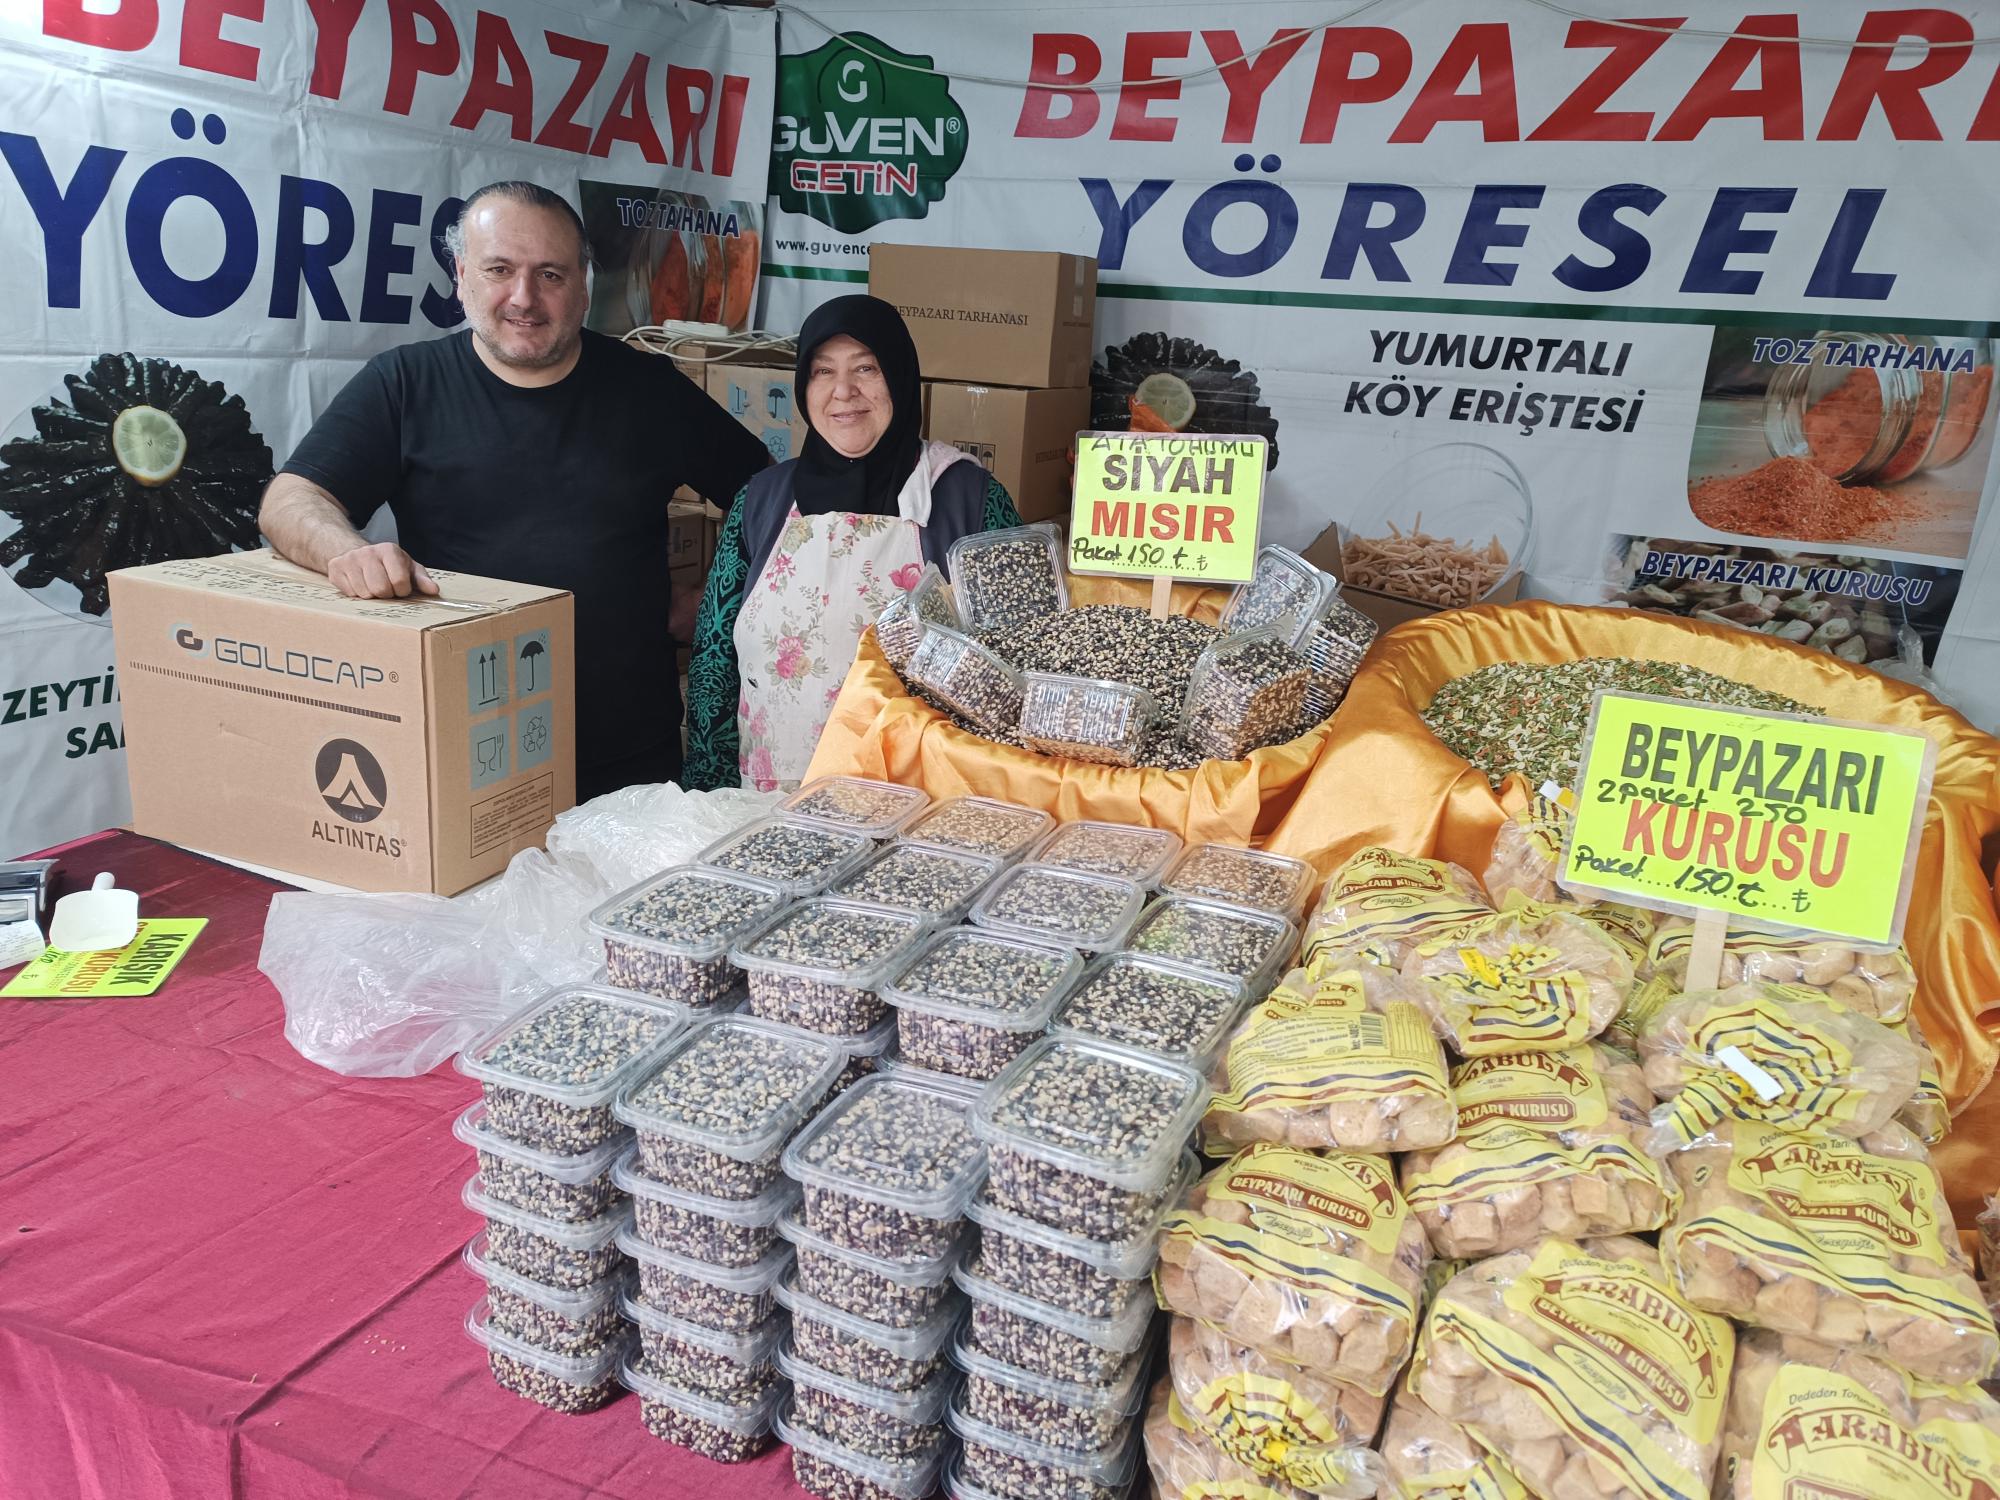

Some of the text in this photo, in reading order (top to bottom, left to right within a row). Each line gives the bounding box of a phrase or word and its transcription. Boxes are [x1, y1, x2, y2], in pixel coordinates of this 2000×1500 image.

[1078, 153, 1898, 301] YÖRESEL
[957, 309, 1029, 327] TARHANASI
[1369, 329, 1633, 377] YUMURTALI
[1753, 337, 1976, 375] TOZ TARHANA
[1343, 374, 1646, 437] KÖY ERİŞTESİ
[1102, 446, 1235, 495] SİYAH
[1090, 500, 1236, 544] MISIR
[1127, 543, 1165, 565] 150
[1640, 550, 1933, 607] BEYPAZARI KURUSU
[1, 665, 121, 726] ZEYTİ
[65, 721, 126, 759] SA
[1620, 721, 1886, 816] BEYPAZARI
[1735, 797, 1808, 824] 250
[1621, 799, 1851, 889] KURUSU
[109, 933, 188, 985] KARIŞIK
[1508, 1103, 1570, 1118] KURUSU
[1231, 1176, 1367, 1225] BEYPAZARI KURUSU
[1625, 1350, 1686, 1407] KURUSU
[1789, 1387, 1838, 1406] Dededen
